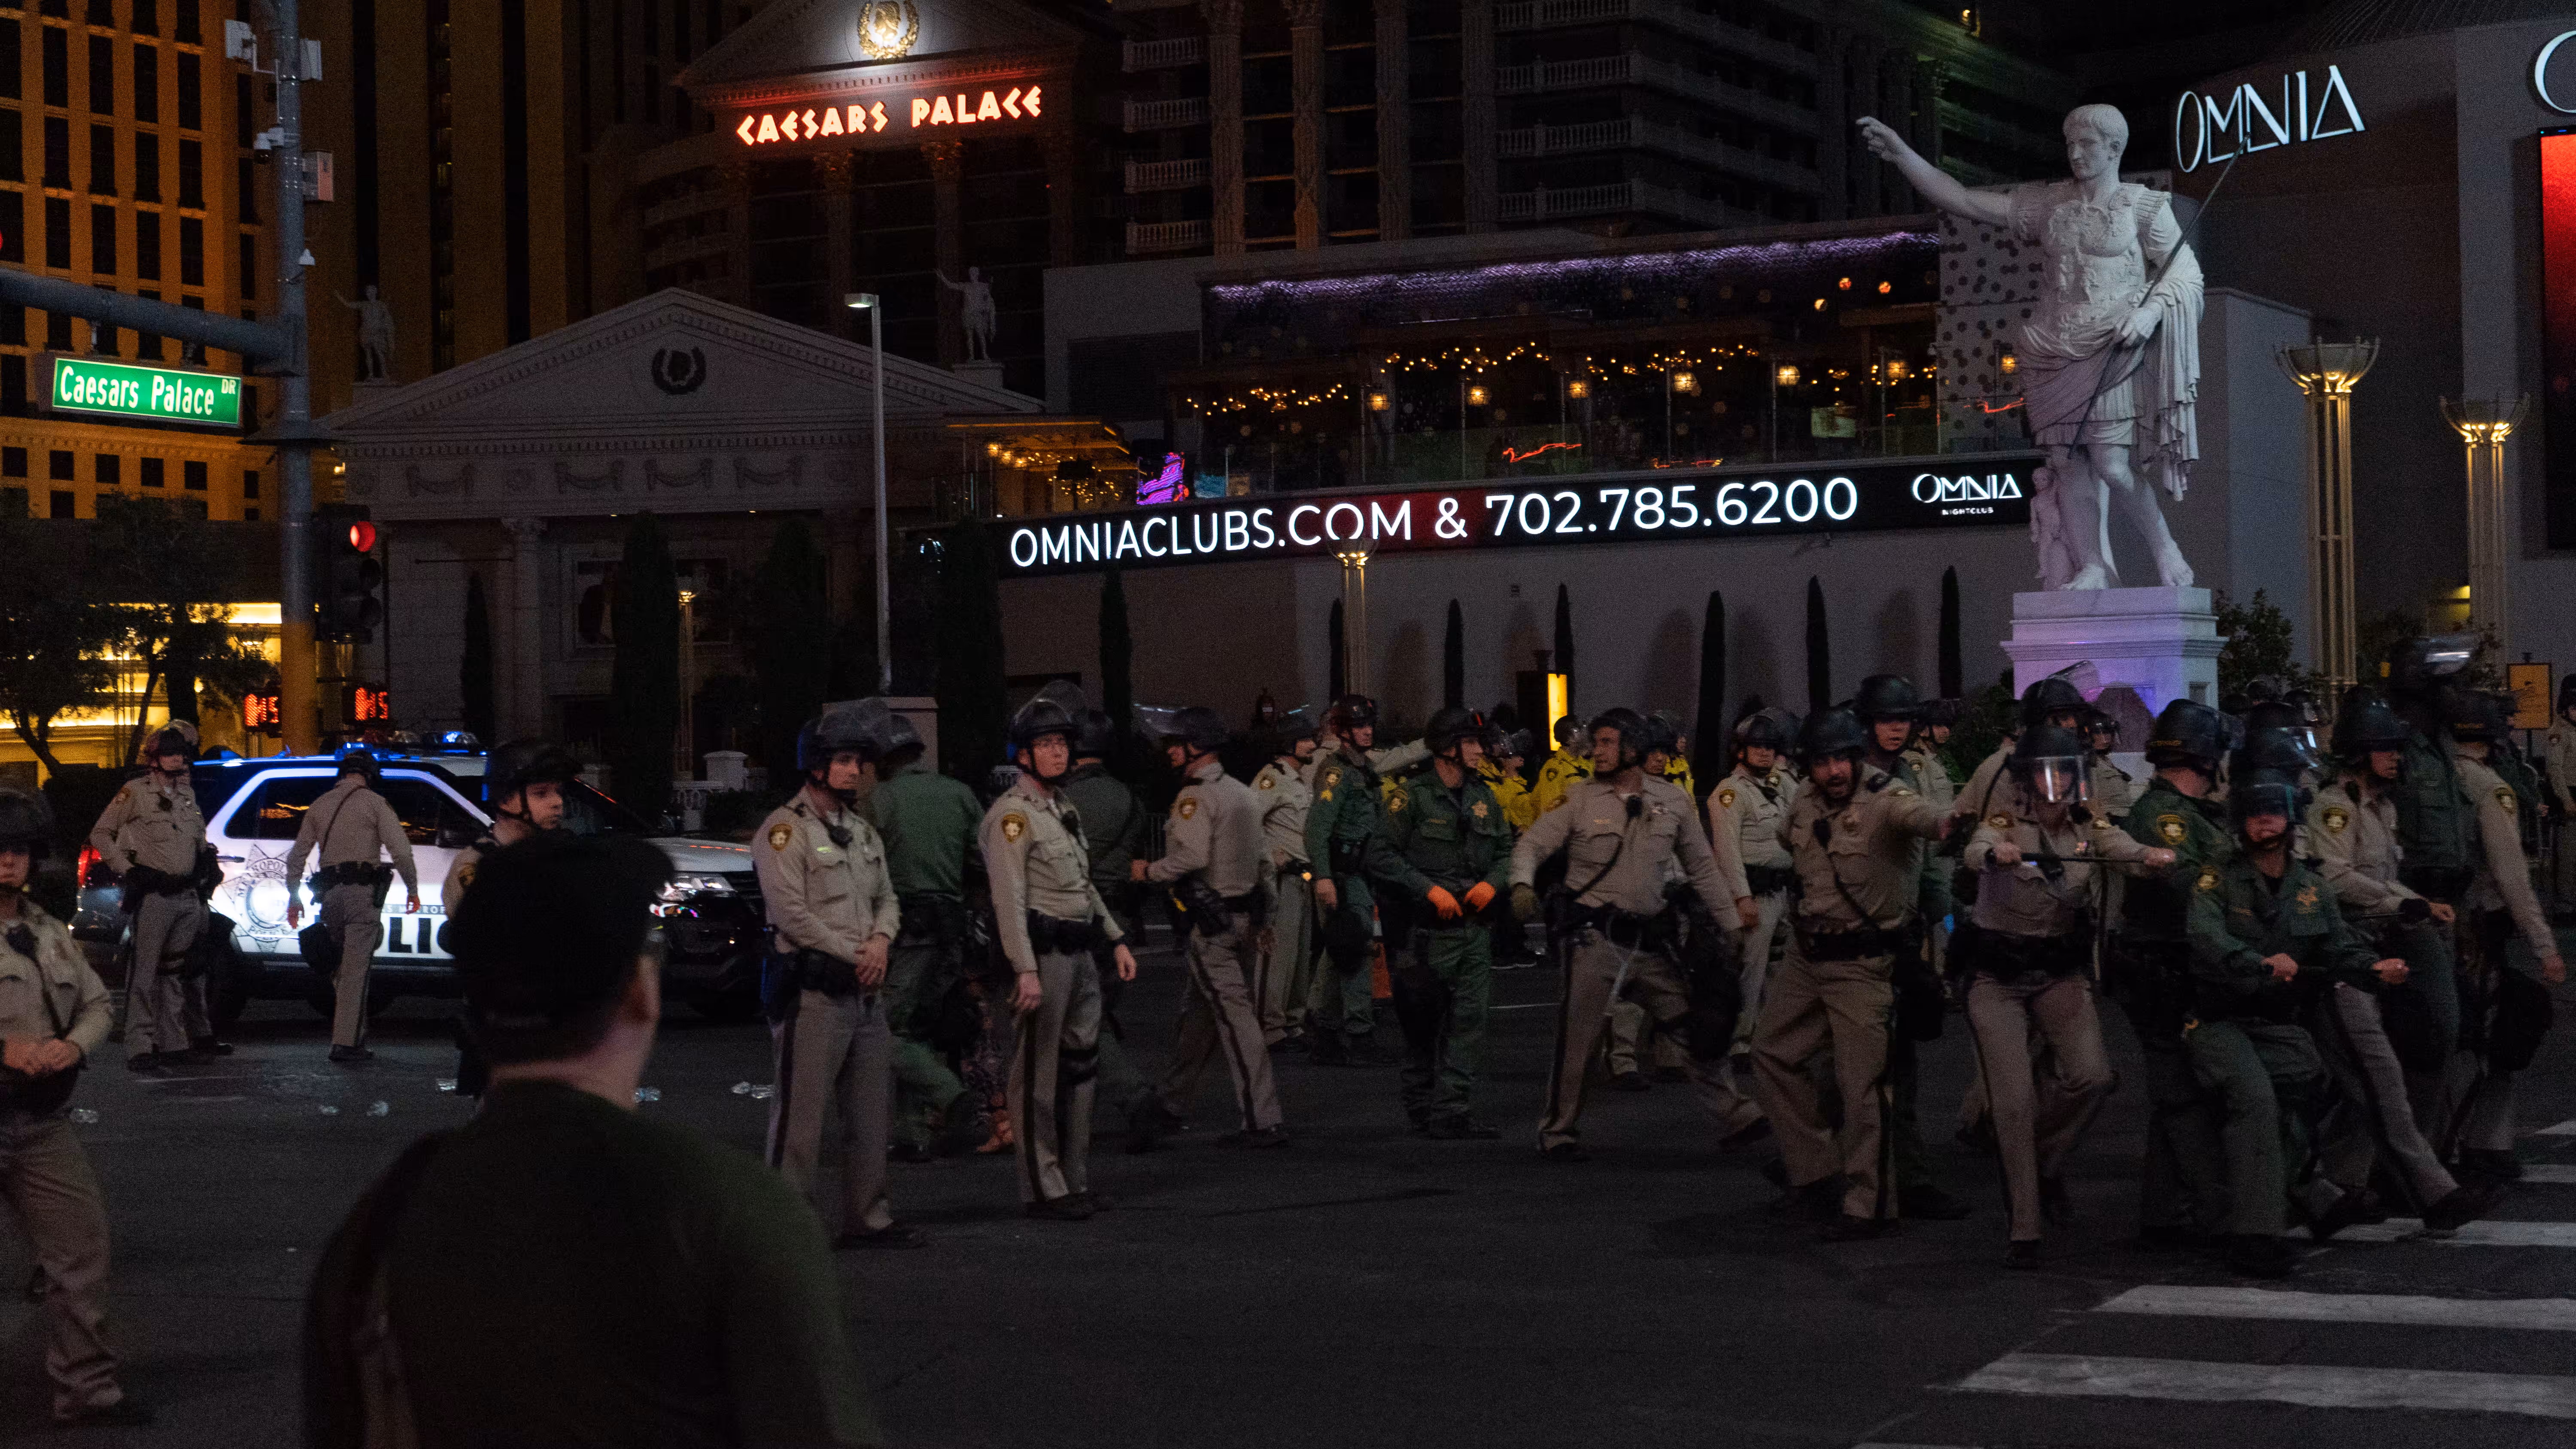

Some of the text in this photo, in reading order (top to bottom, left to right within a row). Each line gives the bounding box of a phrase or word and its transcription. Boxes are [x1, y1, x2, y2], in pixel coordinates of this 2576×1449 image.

[736, 85, 1042, 146] CAESARS PALACE
[2176, 65, 2365, 173] OMNIA
[60, 365, 236, 415] Caesars Palace DR
[1912, 473, 2022, 503] OMNIA
[1941, 507, 1994, 515] NIGHTCLUB
[1011, 477, 1857, 567] OMNIACLUBS.COM & 702.785.6200
